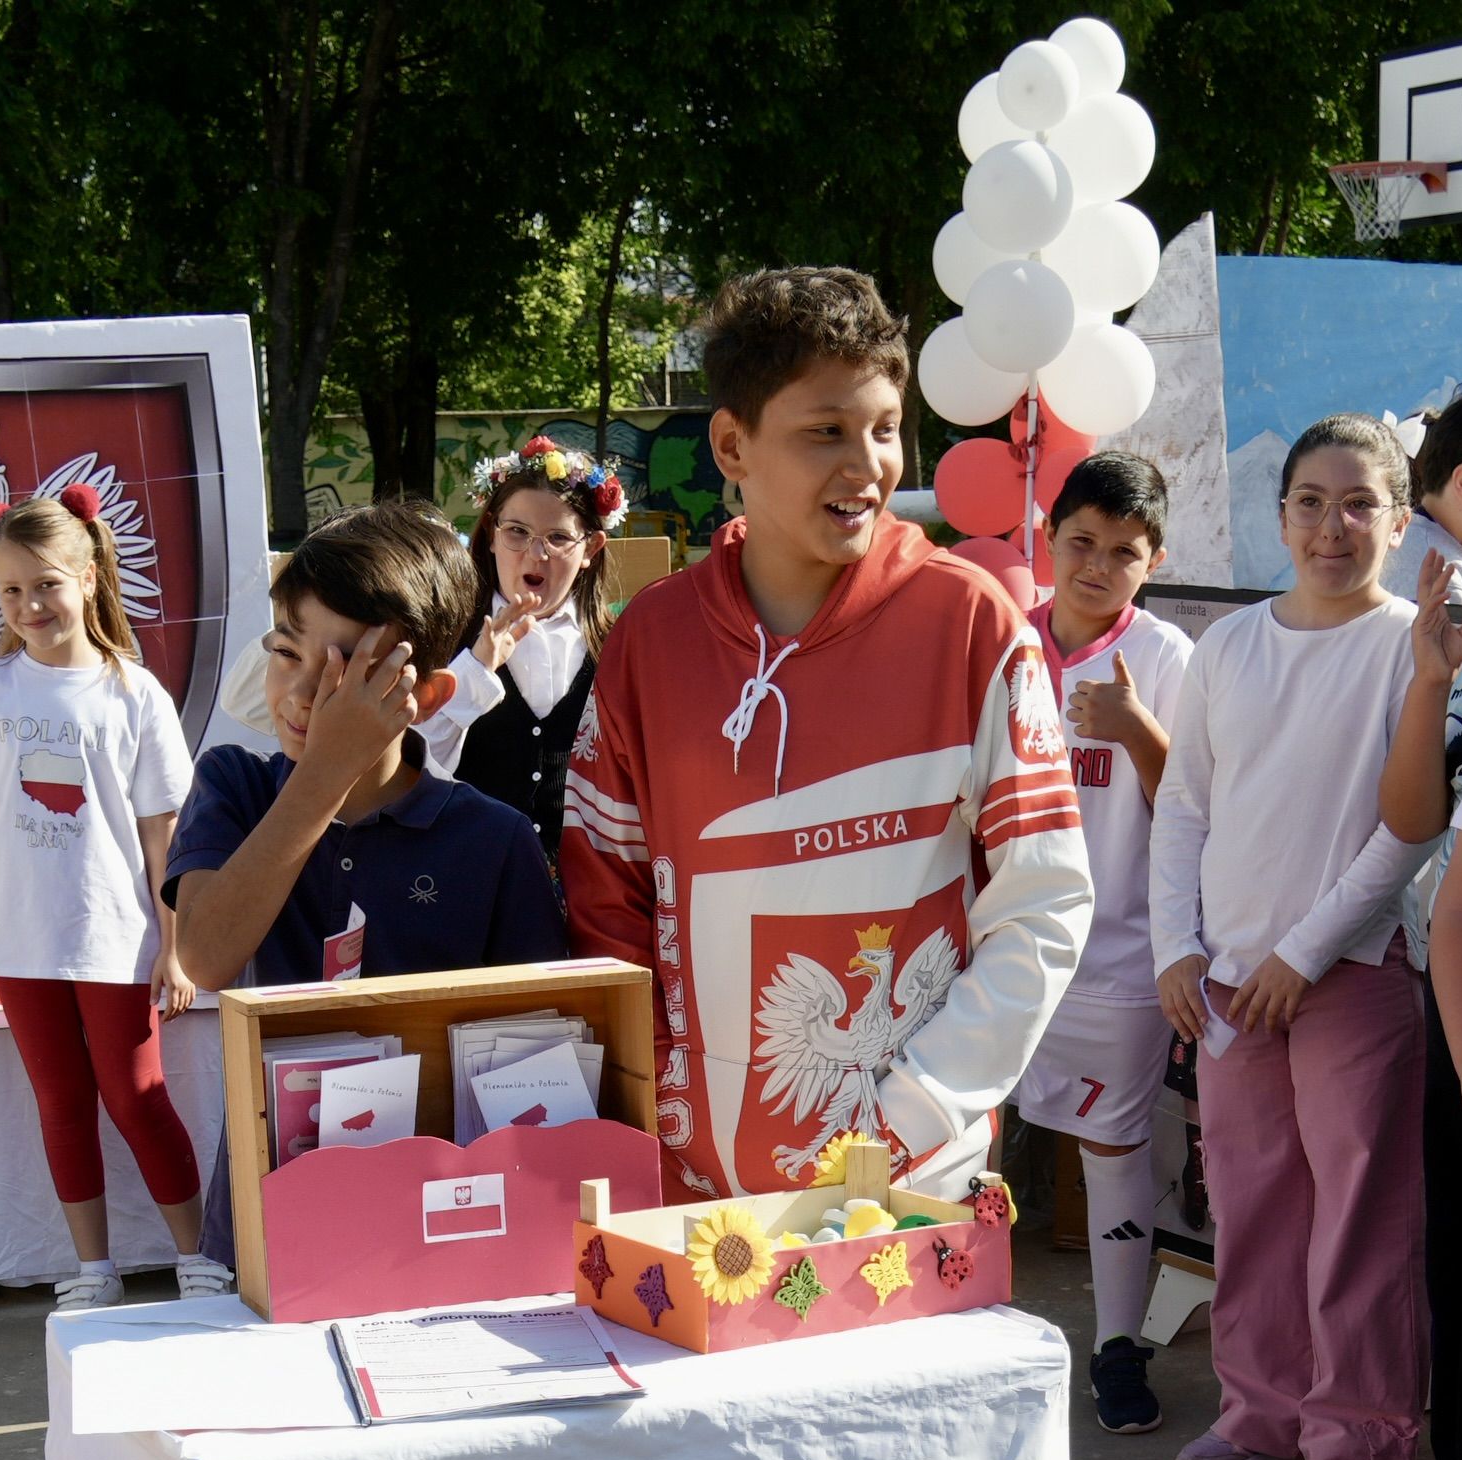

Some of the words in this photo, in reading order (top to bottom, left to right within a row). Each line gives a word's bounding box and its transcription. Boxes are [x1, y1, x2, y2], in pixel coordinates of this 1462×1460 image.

[1071, 747, 1113, 788] ND
[26, 831, 68, 851] DNA
[793, 813, 910, 856] POLSKA
[1075, 1076, 1106, 1118] 7
[420, 1312, 516, 1323] TRADITIONAL
[521, 1310, 575, 1320] GAMES
